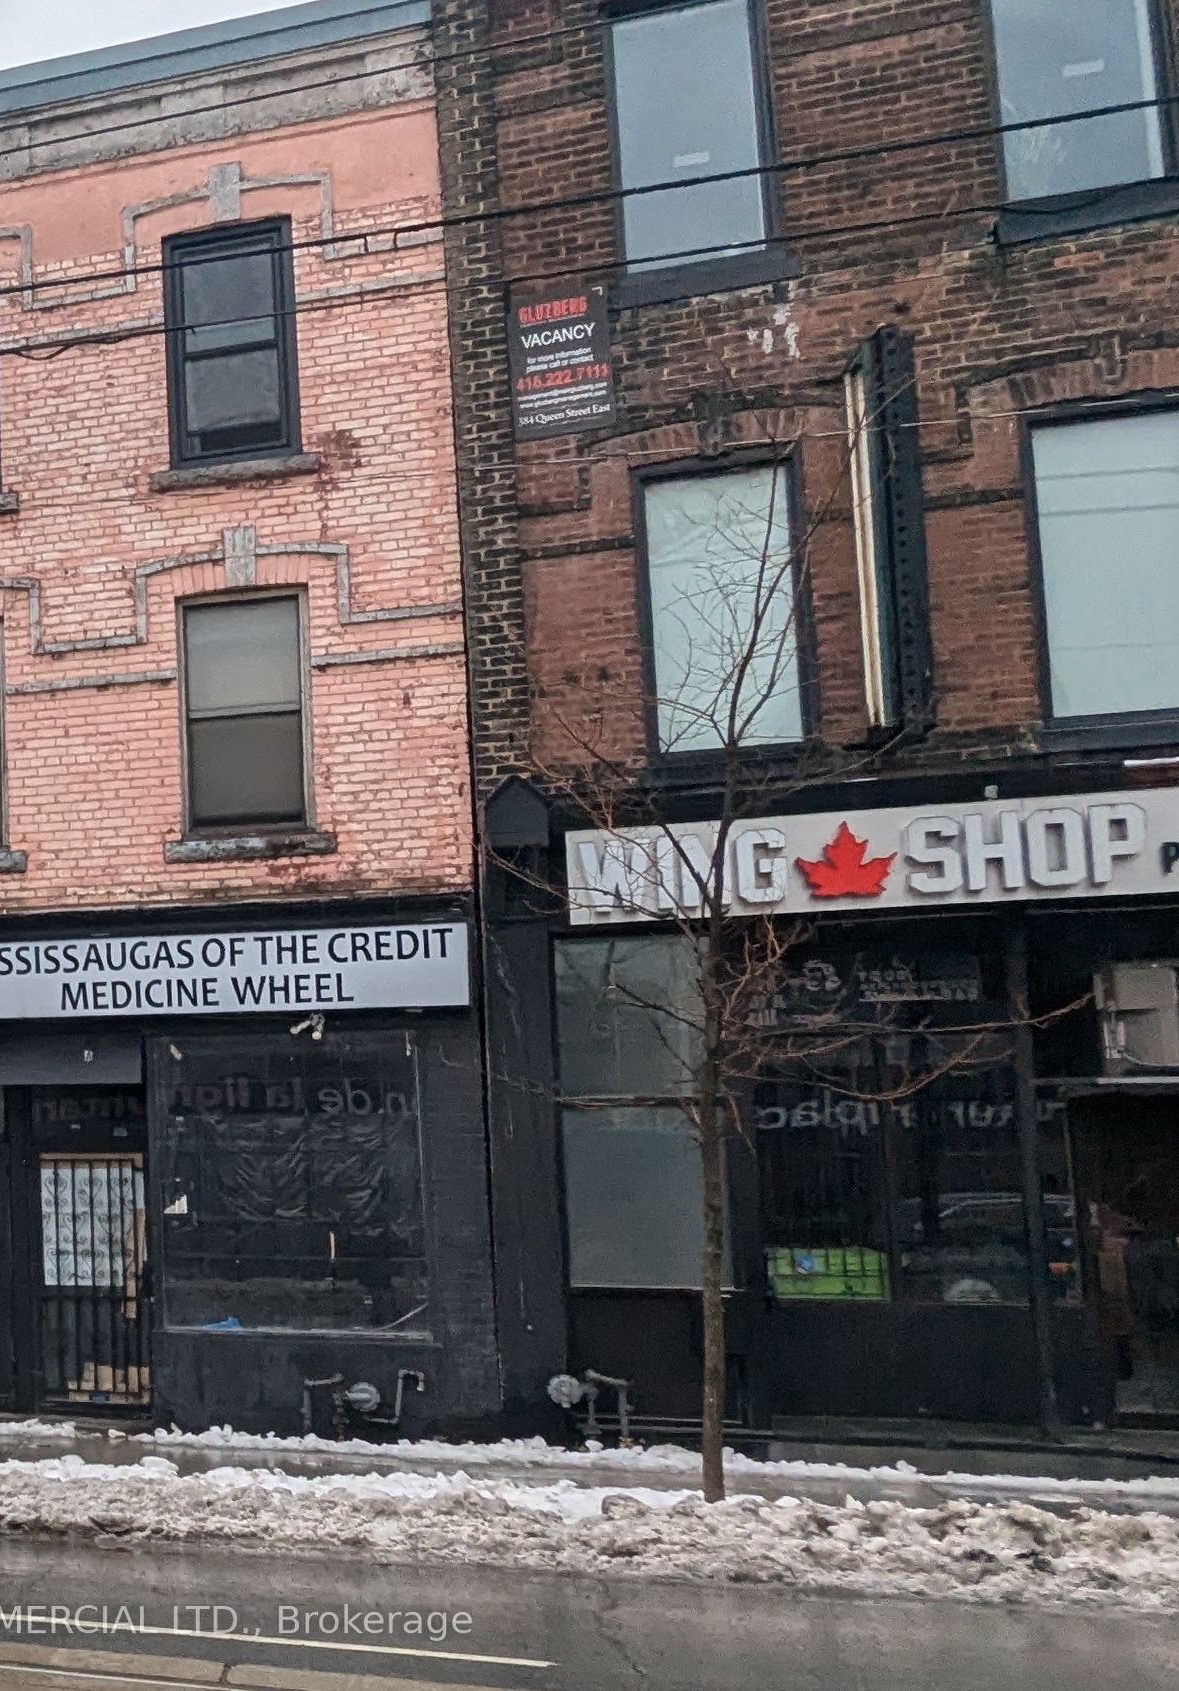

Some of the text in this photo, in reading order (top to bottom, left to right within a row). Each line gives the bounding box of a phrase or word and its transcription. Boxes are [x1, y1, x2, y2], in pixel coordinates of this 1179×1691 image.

[521, 322, 596, 349] VACANCY
[535, 411, 565, 424] Queen
[566, 406, 590, 418] Street
[592, 403, 611, 414] East
[575, 802, 1148, 914] WING SHOP
[204, 937, 247, 968] OF
[253, 933, 322, 966] THE
[328, 928, 453, 963] CREDIT
[61, 973, 354, 1011] MEDICINE WHEEL
